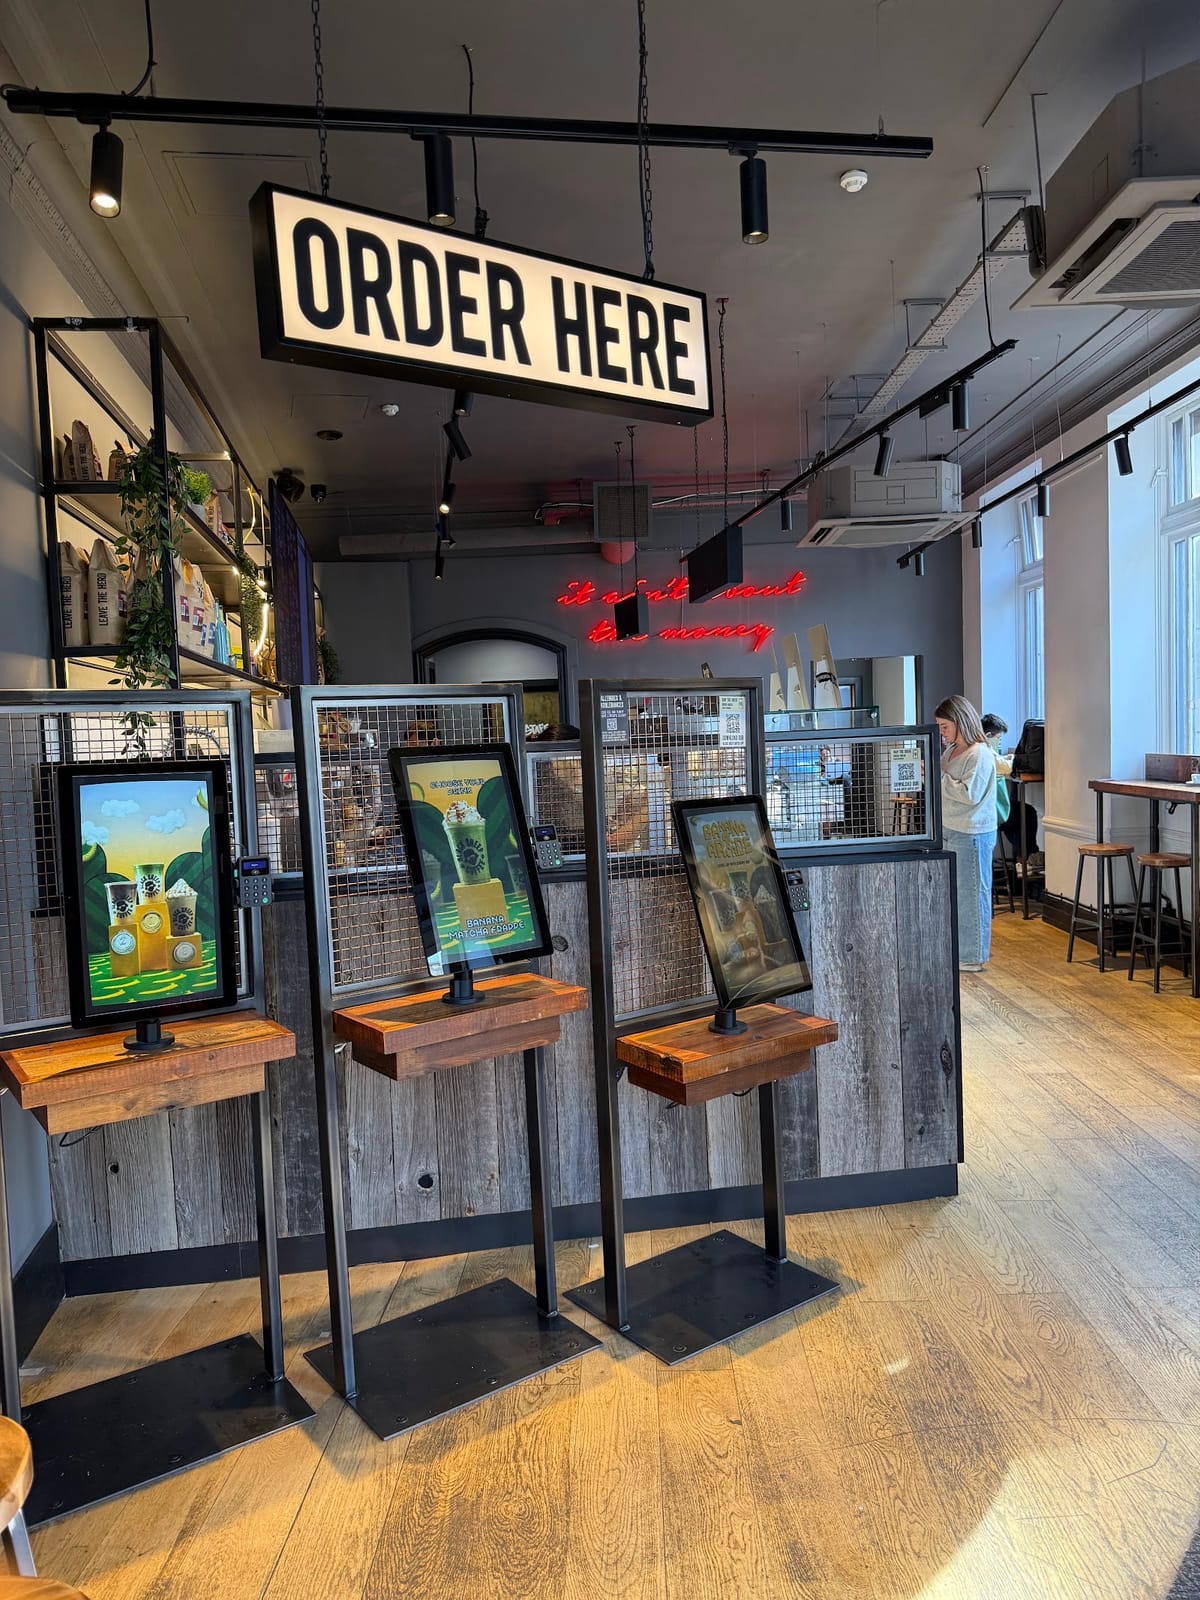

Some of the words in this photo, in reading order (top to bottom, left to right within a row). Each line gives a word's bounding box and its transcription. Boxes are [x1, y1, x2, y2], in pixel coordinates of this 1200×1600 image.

[293, 217, 532, 367] ORDER
[551, 276, 697, 397] HERE
[62, 576, 72, 592] HERD
[96, 572, 107, 590] HERD
[97, 592, 107, 604] THE
[557, 581, 596, 606] it
[602, 576, 690, 604] an't
[63, 594, 72, 607] THE
[63, 610, 73, 629] LEAVE
[98, 606, 109, 627] LEAVE
[658, 623, 775, 652] money
[703, 820, 748, 841] BANANA
[466, 914, 505, 928] BANANA
[448, 928, 488, 939] MATCHA
